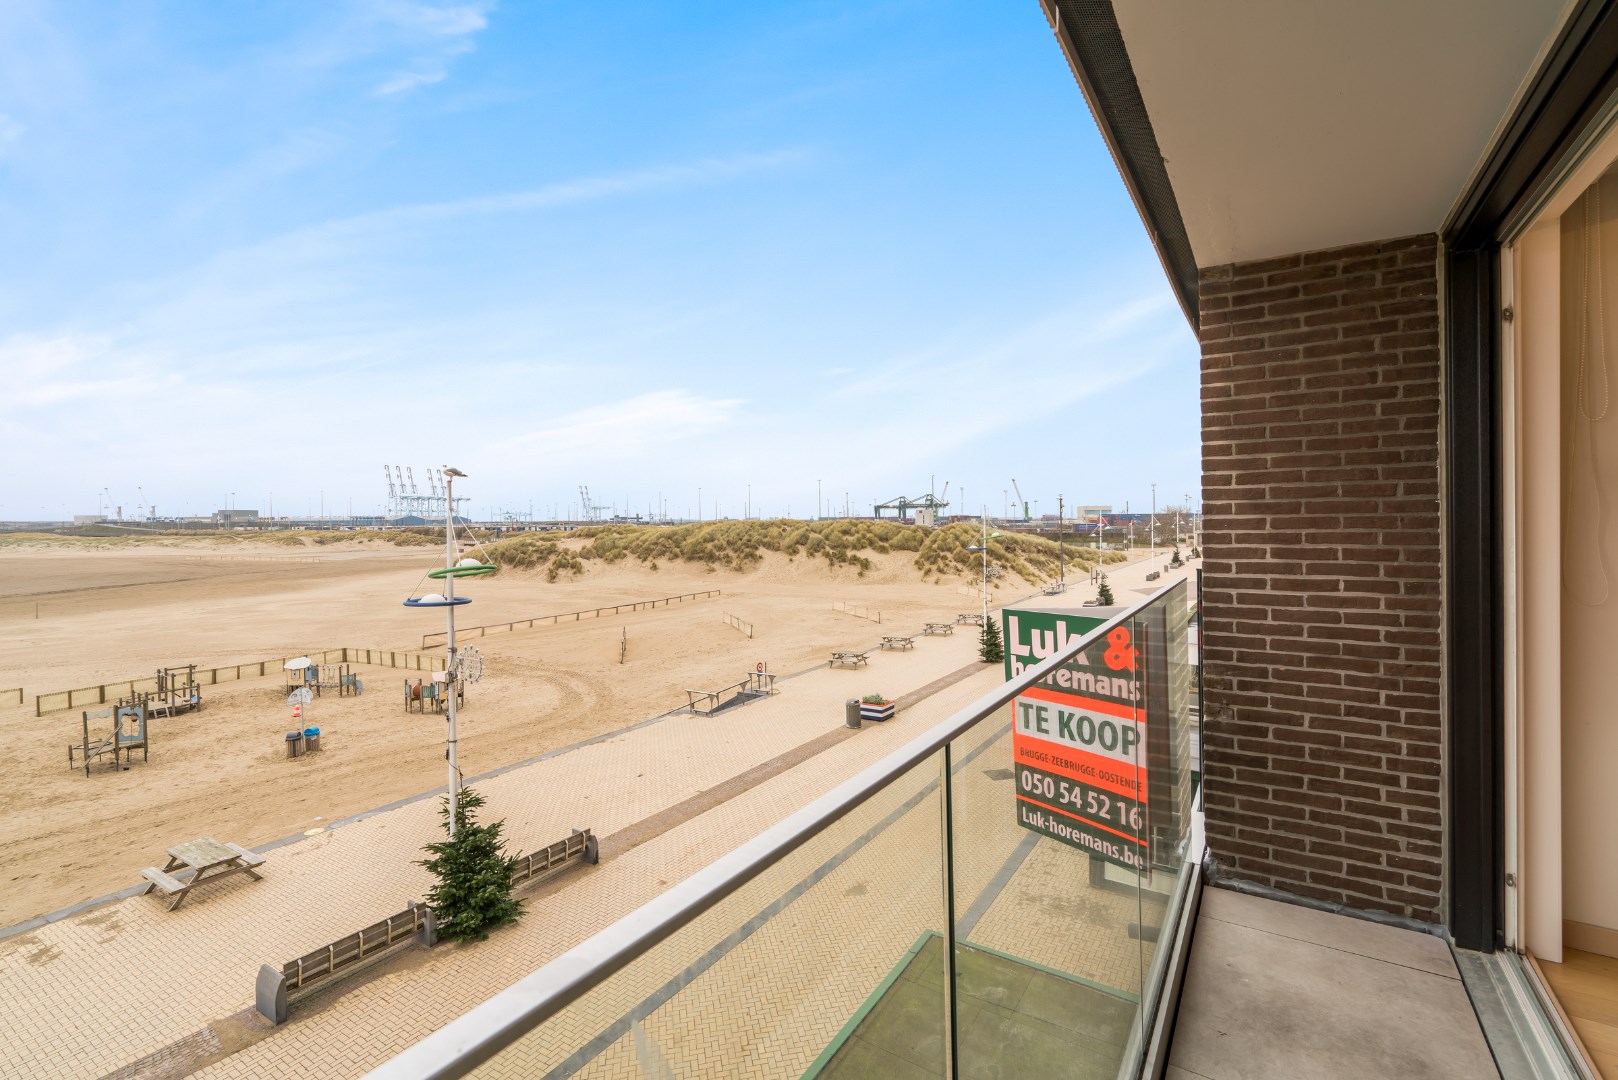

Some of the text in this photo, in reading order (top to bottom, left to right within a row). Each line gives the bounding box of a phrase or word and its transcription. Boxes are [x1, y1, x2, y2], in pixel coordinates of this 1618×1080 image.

[1009, 616, 1139, 672] Luk &
[1019, 702, 1141, 758] TE KOOP
[1021, 770, 1143, 831] 050 54 52 16
[1022, 806, 1144, 870] Luk-horemans.be
